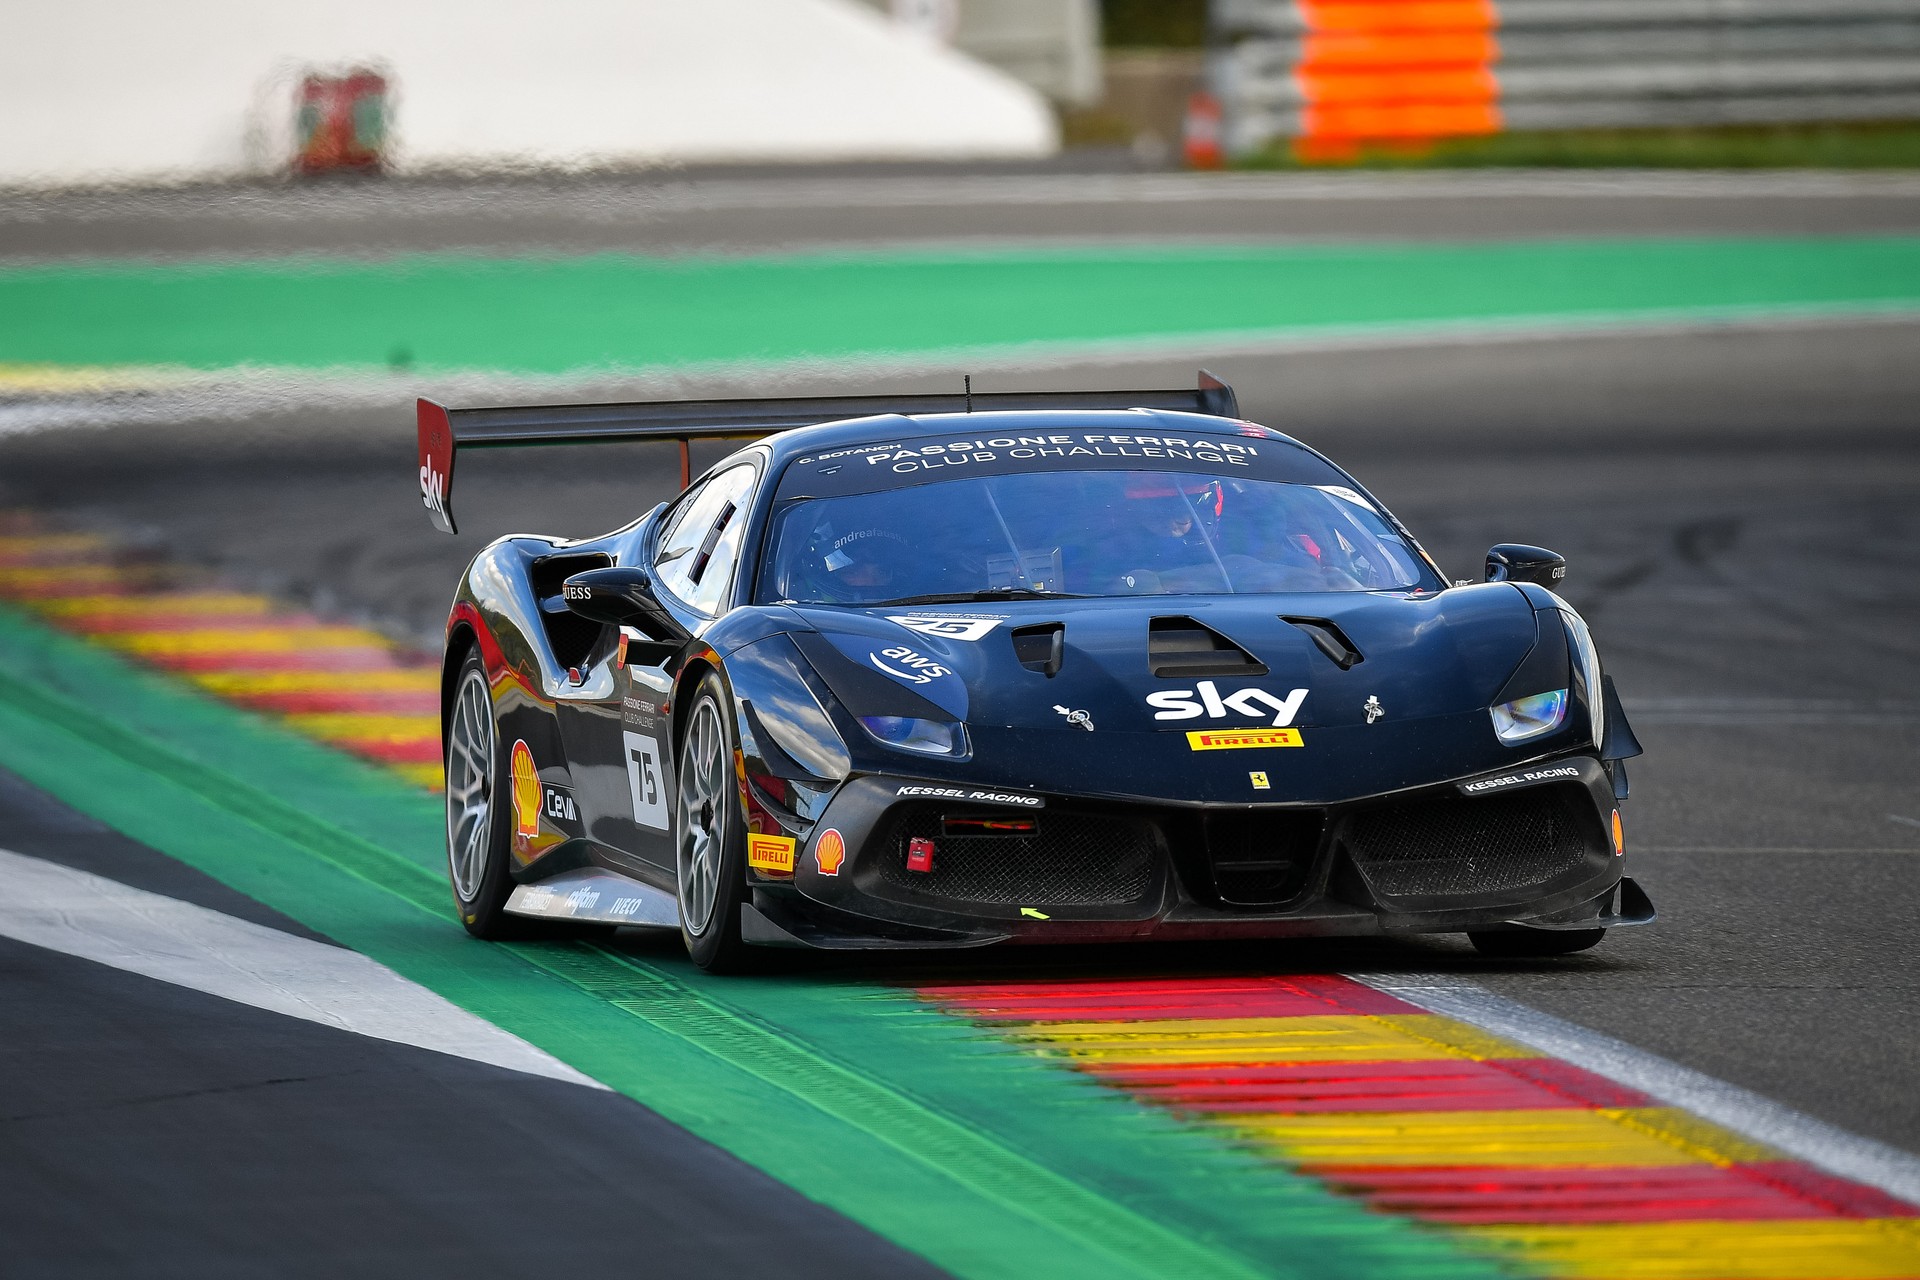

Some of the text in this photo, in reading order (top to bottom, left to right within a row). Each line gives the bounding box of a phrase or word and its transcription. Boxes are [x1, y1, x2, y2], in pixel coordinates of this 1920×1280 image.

[866, 435, 1258, 465] PASSIONE FERRARI
[892, 446, 1250, 473] CLUB CHALLENGE
[420, 453, 449, 527] sky
[1550, 566, 1566, 579] GUE
[881, 646, 952, 678] aws
[1145, 680, 1310, 727] sky
[1200, 732, 1290, 746] PIRELLI
[630, 748, 658, 806] 75
[1465, 767, 1580, 792] KESSEL RACING
[896, 786, 1039, 805] KESSEL RACING
[752, 840, 790, 864] PIRELLI
[609, 897, 643, 915] IVECO
